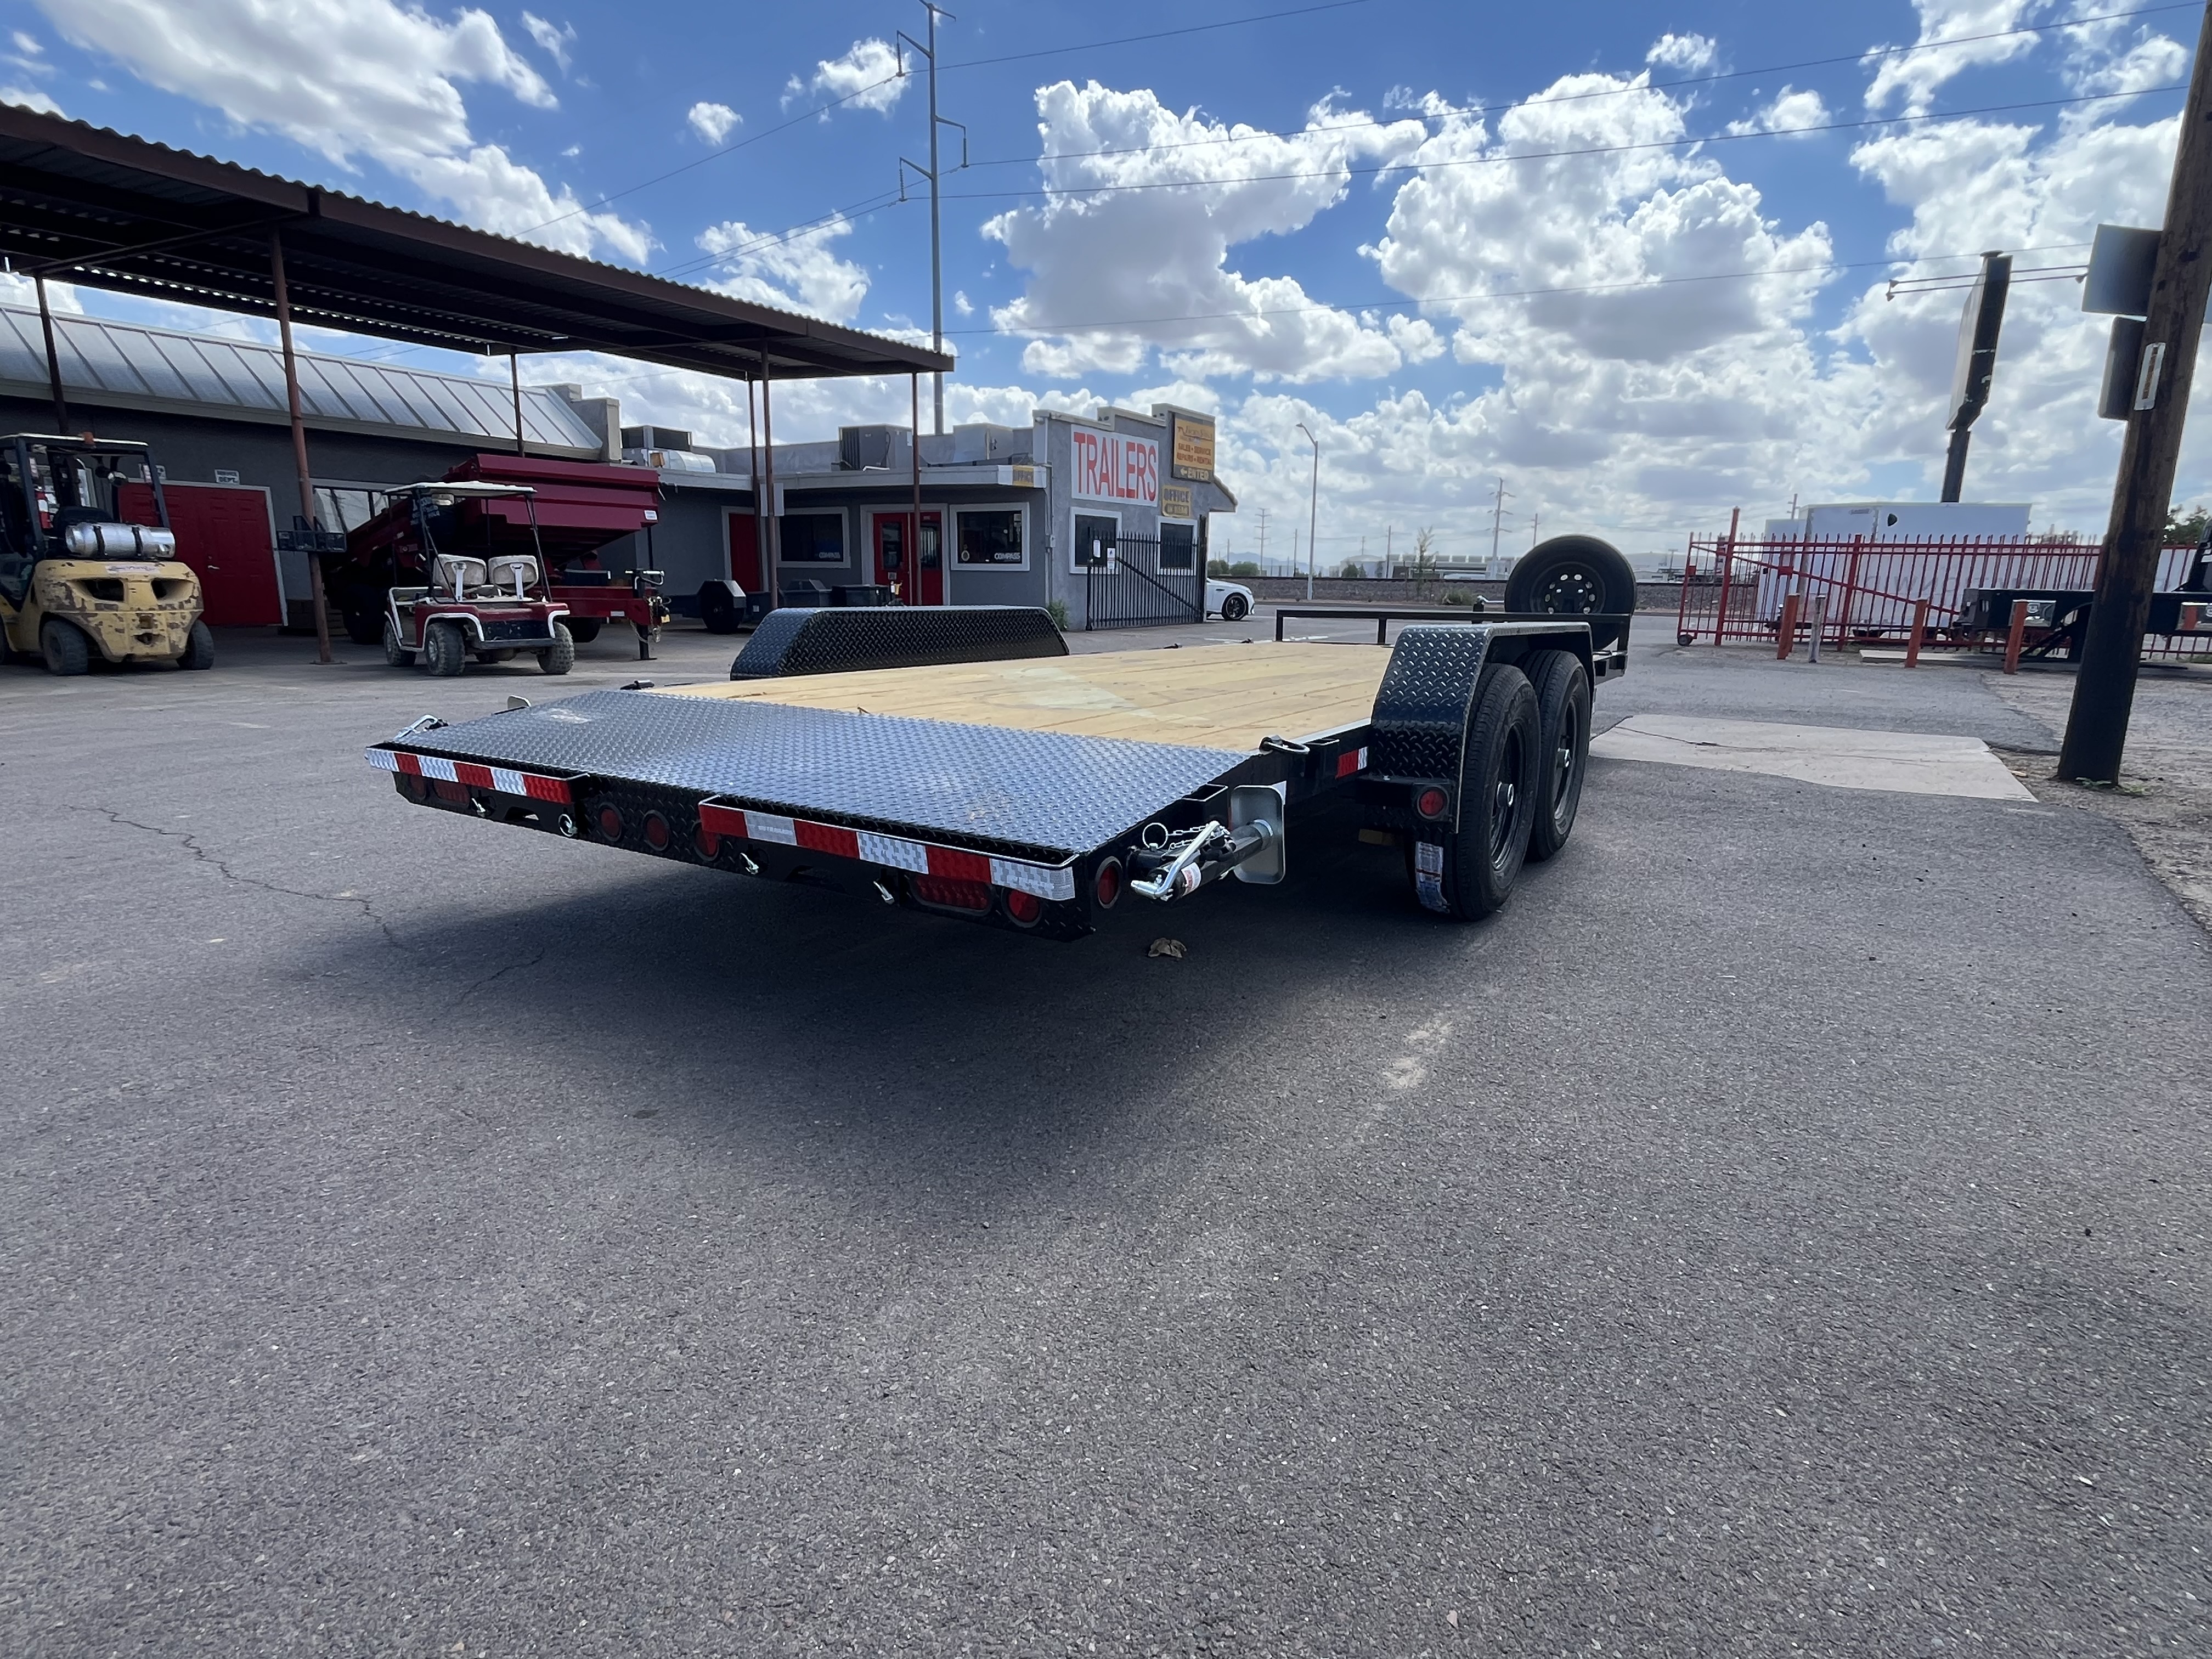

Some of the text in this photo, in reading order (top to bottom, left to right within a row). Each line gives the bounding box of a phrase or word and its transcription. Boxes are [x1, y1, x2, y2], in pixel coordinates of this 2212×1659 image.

[1074, 431, 1156, 501] TRAILERS
[1187, 467, 1209, 481] ENTER
[1164, 488, 1189, 503] OFFICE
